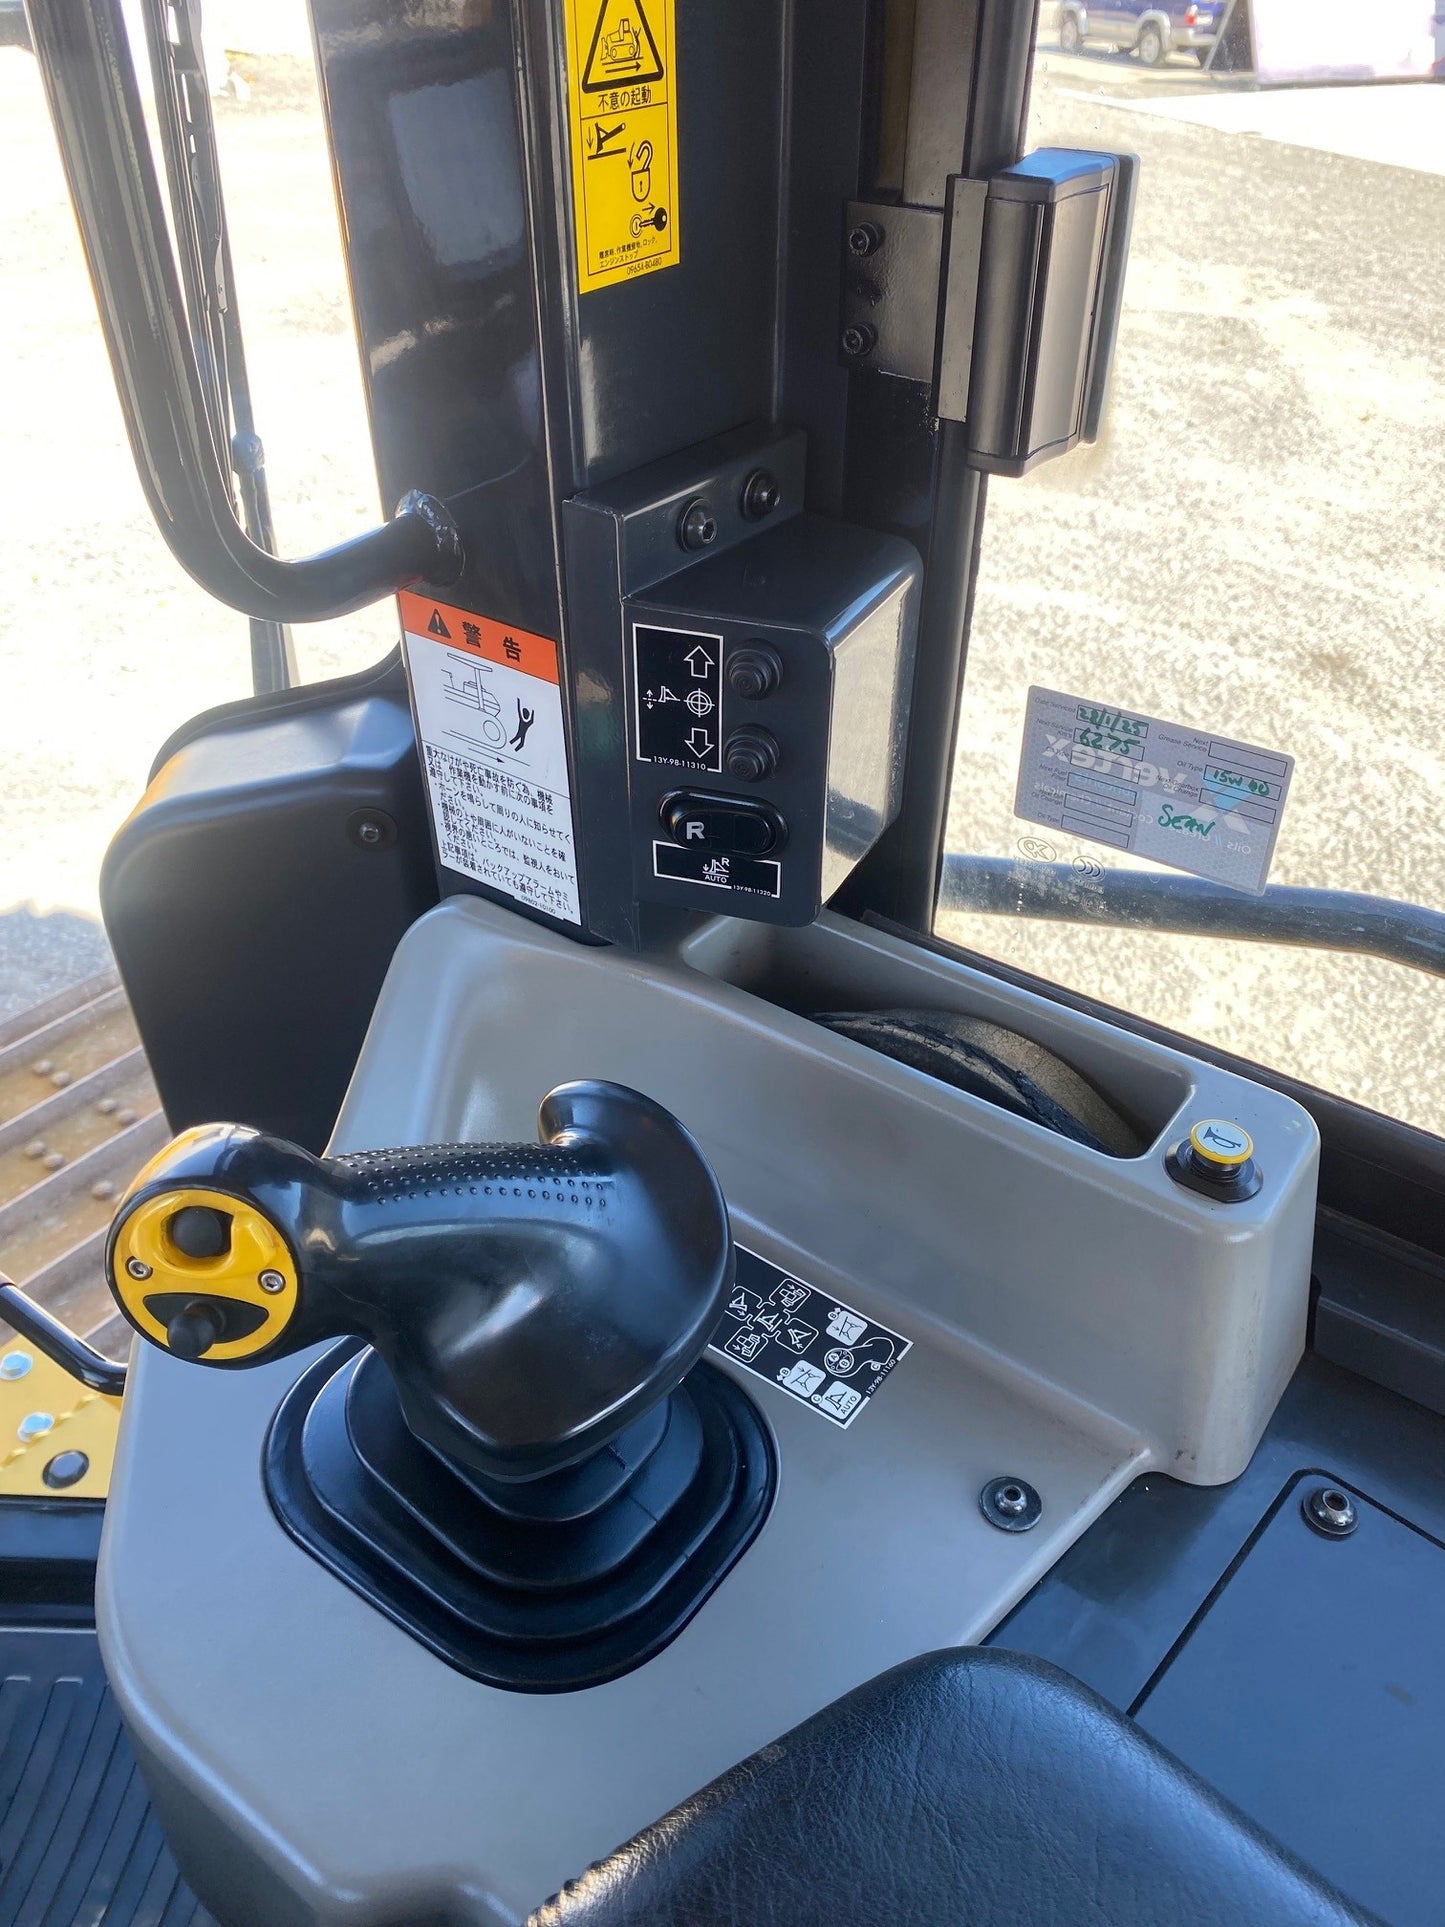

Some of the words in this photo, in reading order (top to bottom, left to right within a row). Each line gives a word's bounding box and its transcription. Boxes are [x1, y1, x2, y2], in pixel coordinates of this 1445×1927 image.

[598, 85, 652, 112] 不意の起動
[462, 621, 522, 662] 警告
[1079, 708, 1149, 735] 28/1/25
[1080, 727, 1140, 755] 6275
[1157, 732, 1182, 745] Grease
[1182, 739, 1208, 752] Service
[1192, 736, 1209, 746] Next
[654, 755, 706, 770] 13Y-98-11310
[1176, 759, 1186, 767] Oil
[1186, 762, 1203, 773] Type
[686, 821, 705, 840] R
[721, 857, 730, 867] R
[704, 874, 728, 884] AUTO
[840, 1395, 858, 1414] AUTO
